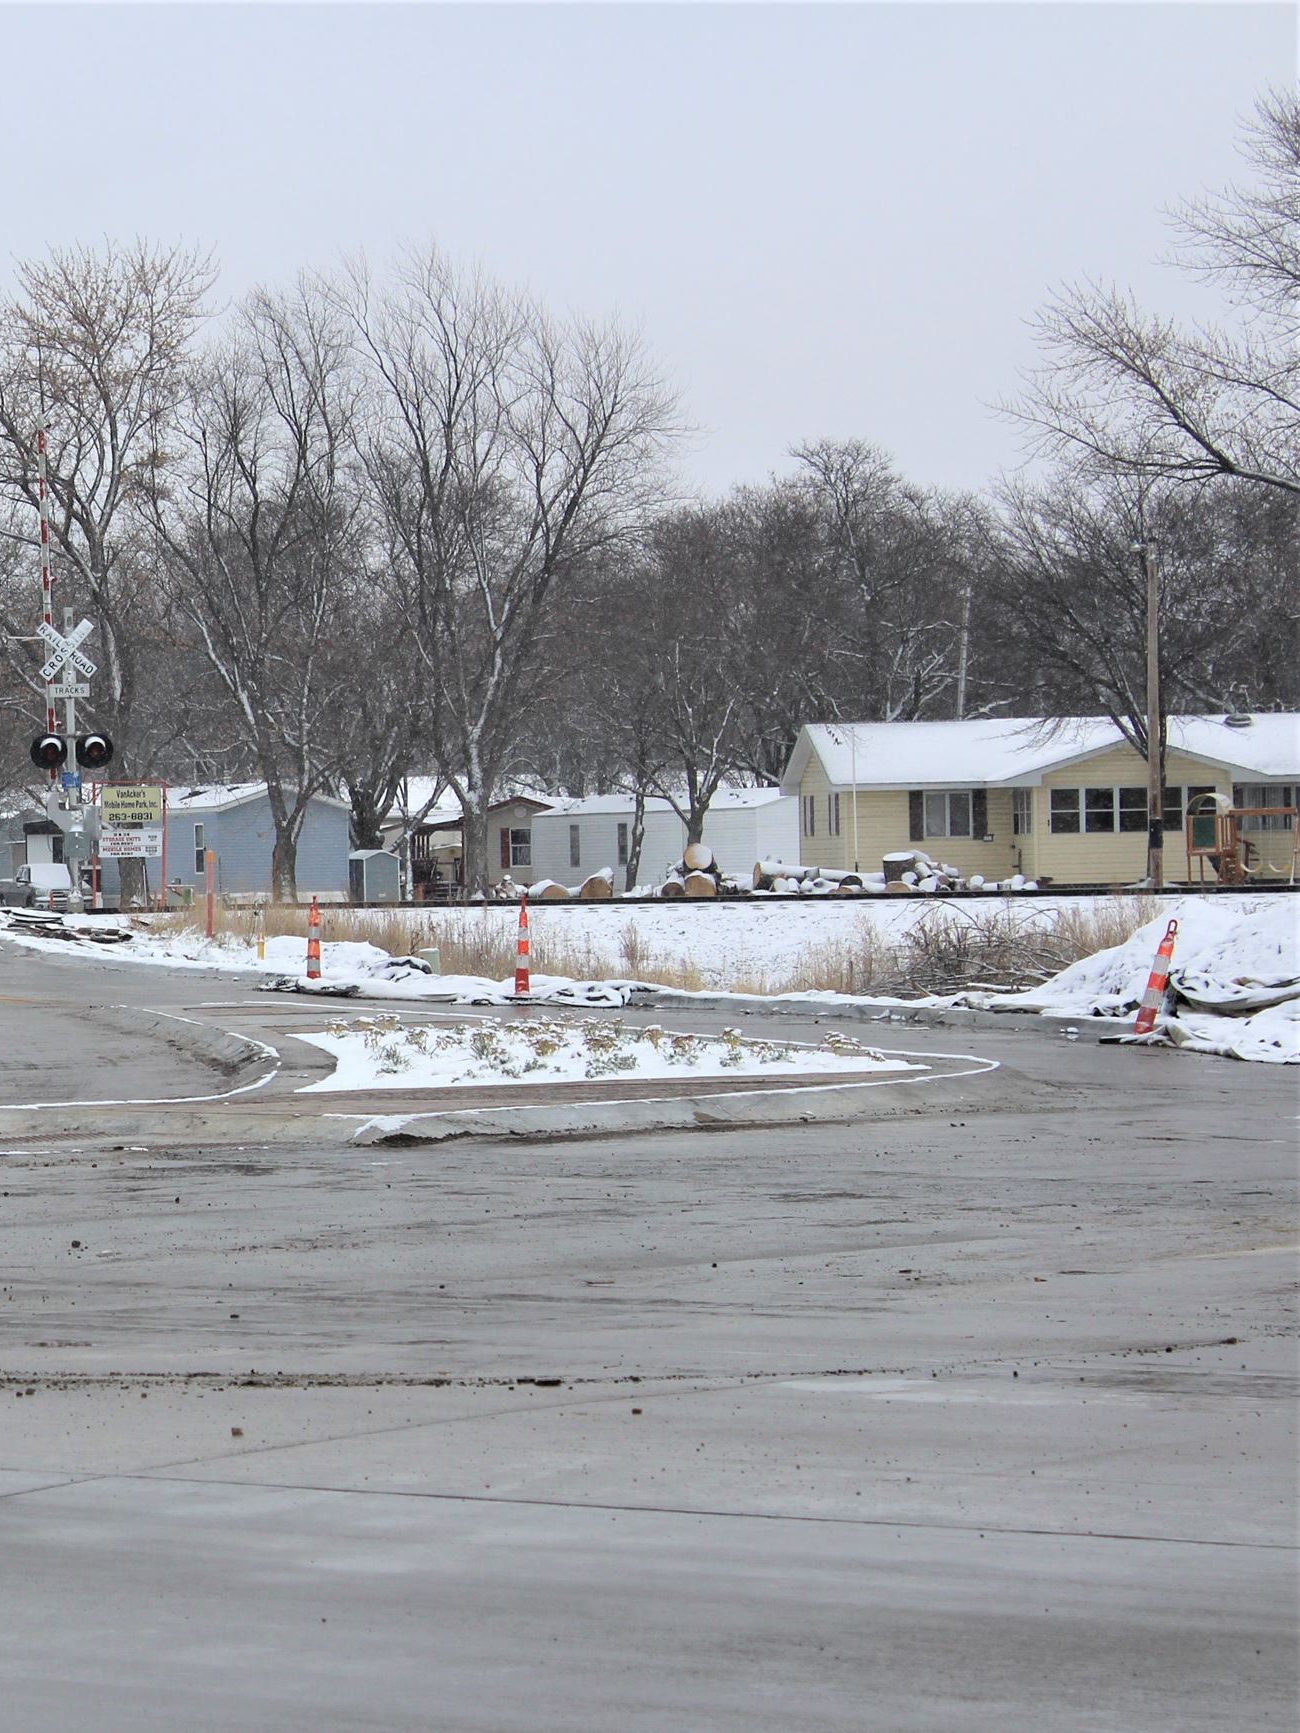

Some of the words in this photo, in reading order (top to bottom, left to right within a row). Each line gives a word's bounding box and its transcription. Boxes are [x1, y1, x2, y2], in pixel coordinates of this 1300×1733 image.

[116, 790, 146, 799] VanAcker's
[104, 801, 120, 809] Mobile
[120, 801, 135, 809] Home
[135, 801, 148, 810] Park,
[149, 801, 158, 809] Inc.
[109, 812, 153, 821] 263-8831
